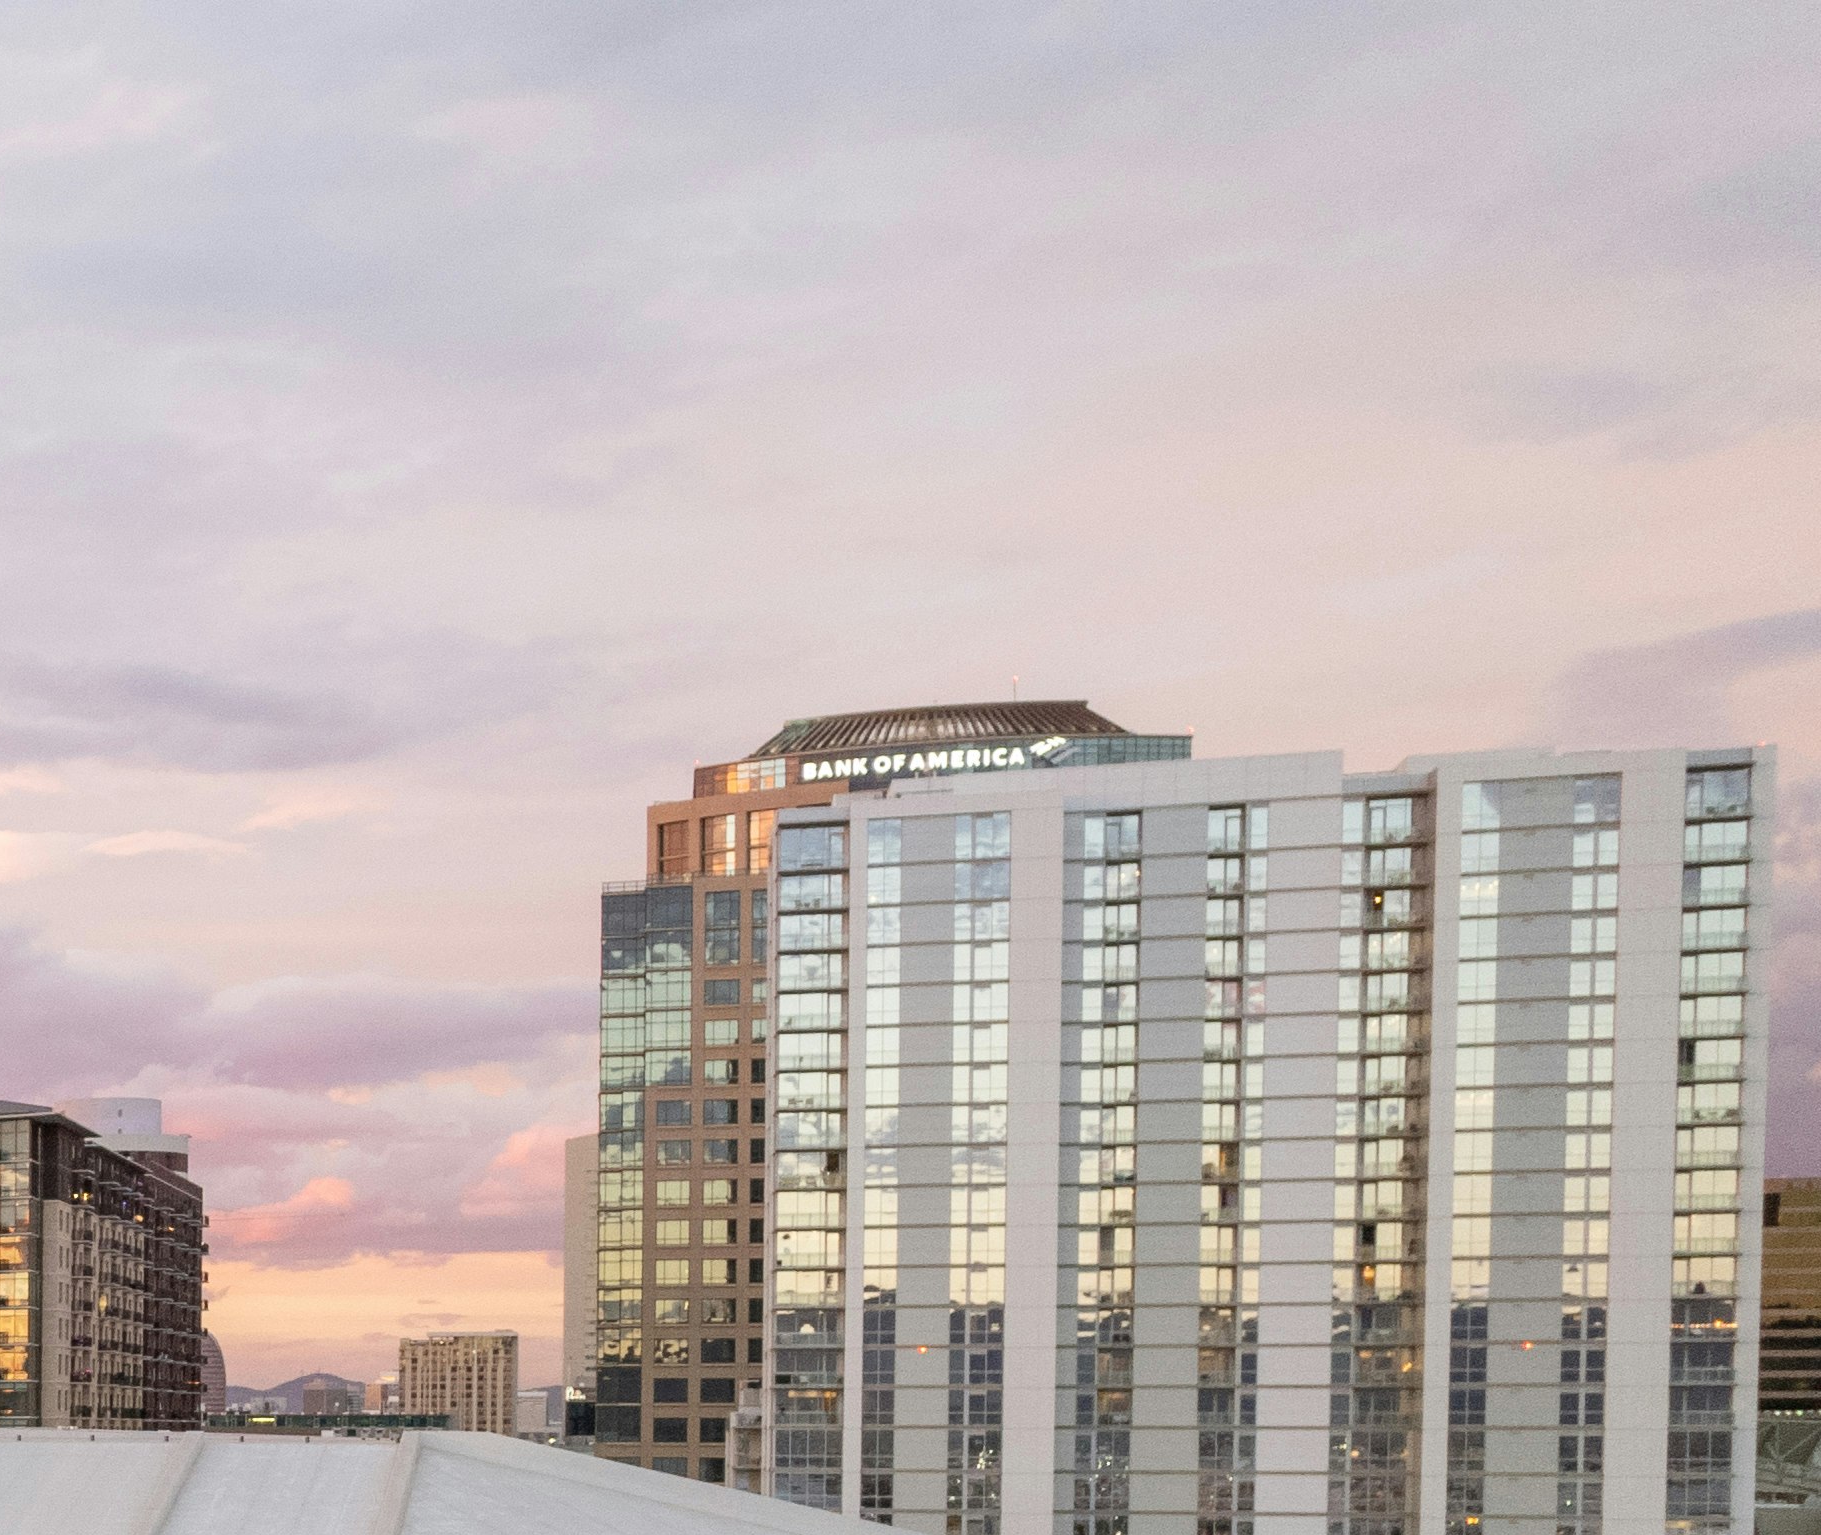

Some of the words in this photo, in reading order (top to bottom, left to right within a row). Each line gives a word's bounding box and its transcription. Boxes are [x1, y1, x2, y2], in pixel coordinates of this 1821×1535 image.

[802, 757, 868, 781] BANK
[873, 754, 907, 774] OF
[910, 747, 1025, 772] AMERICA
